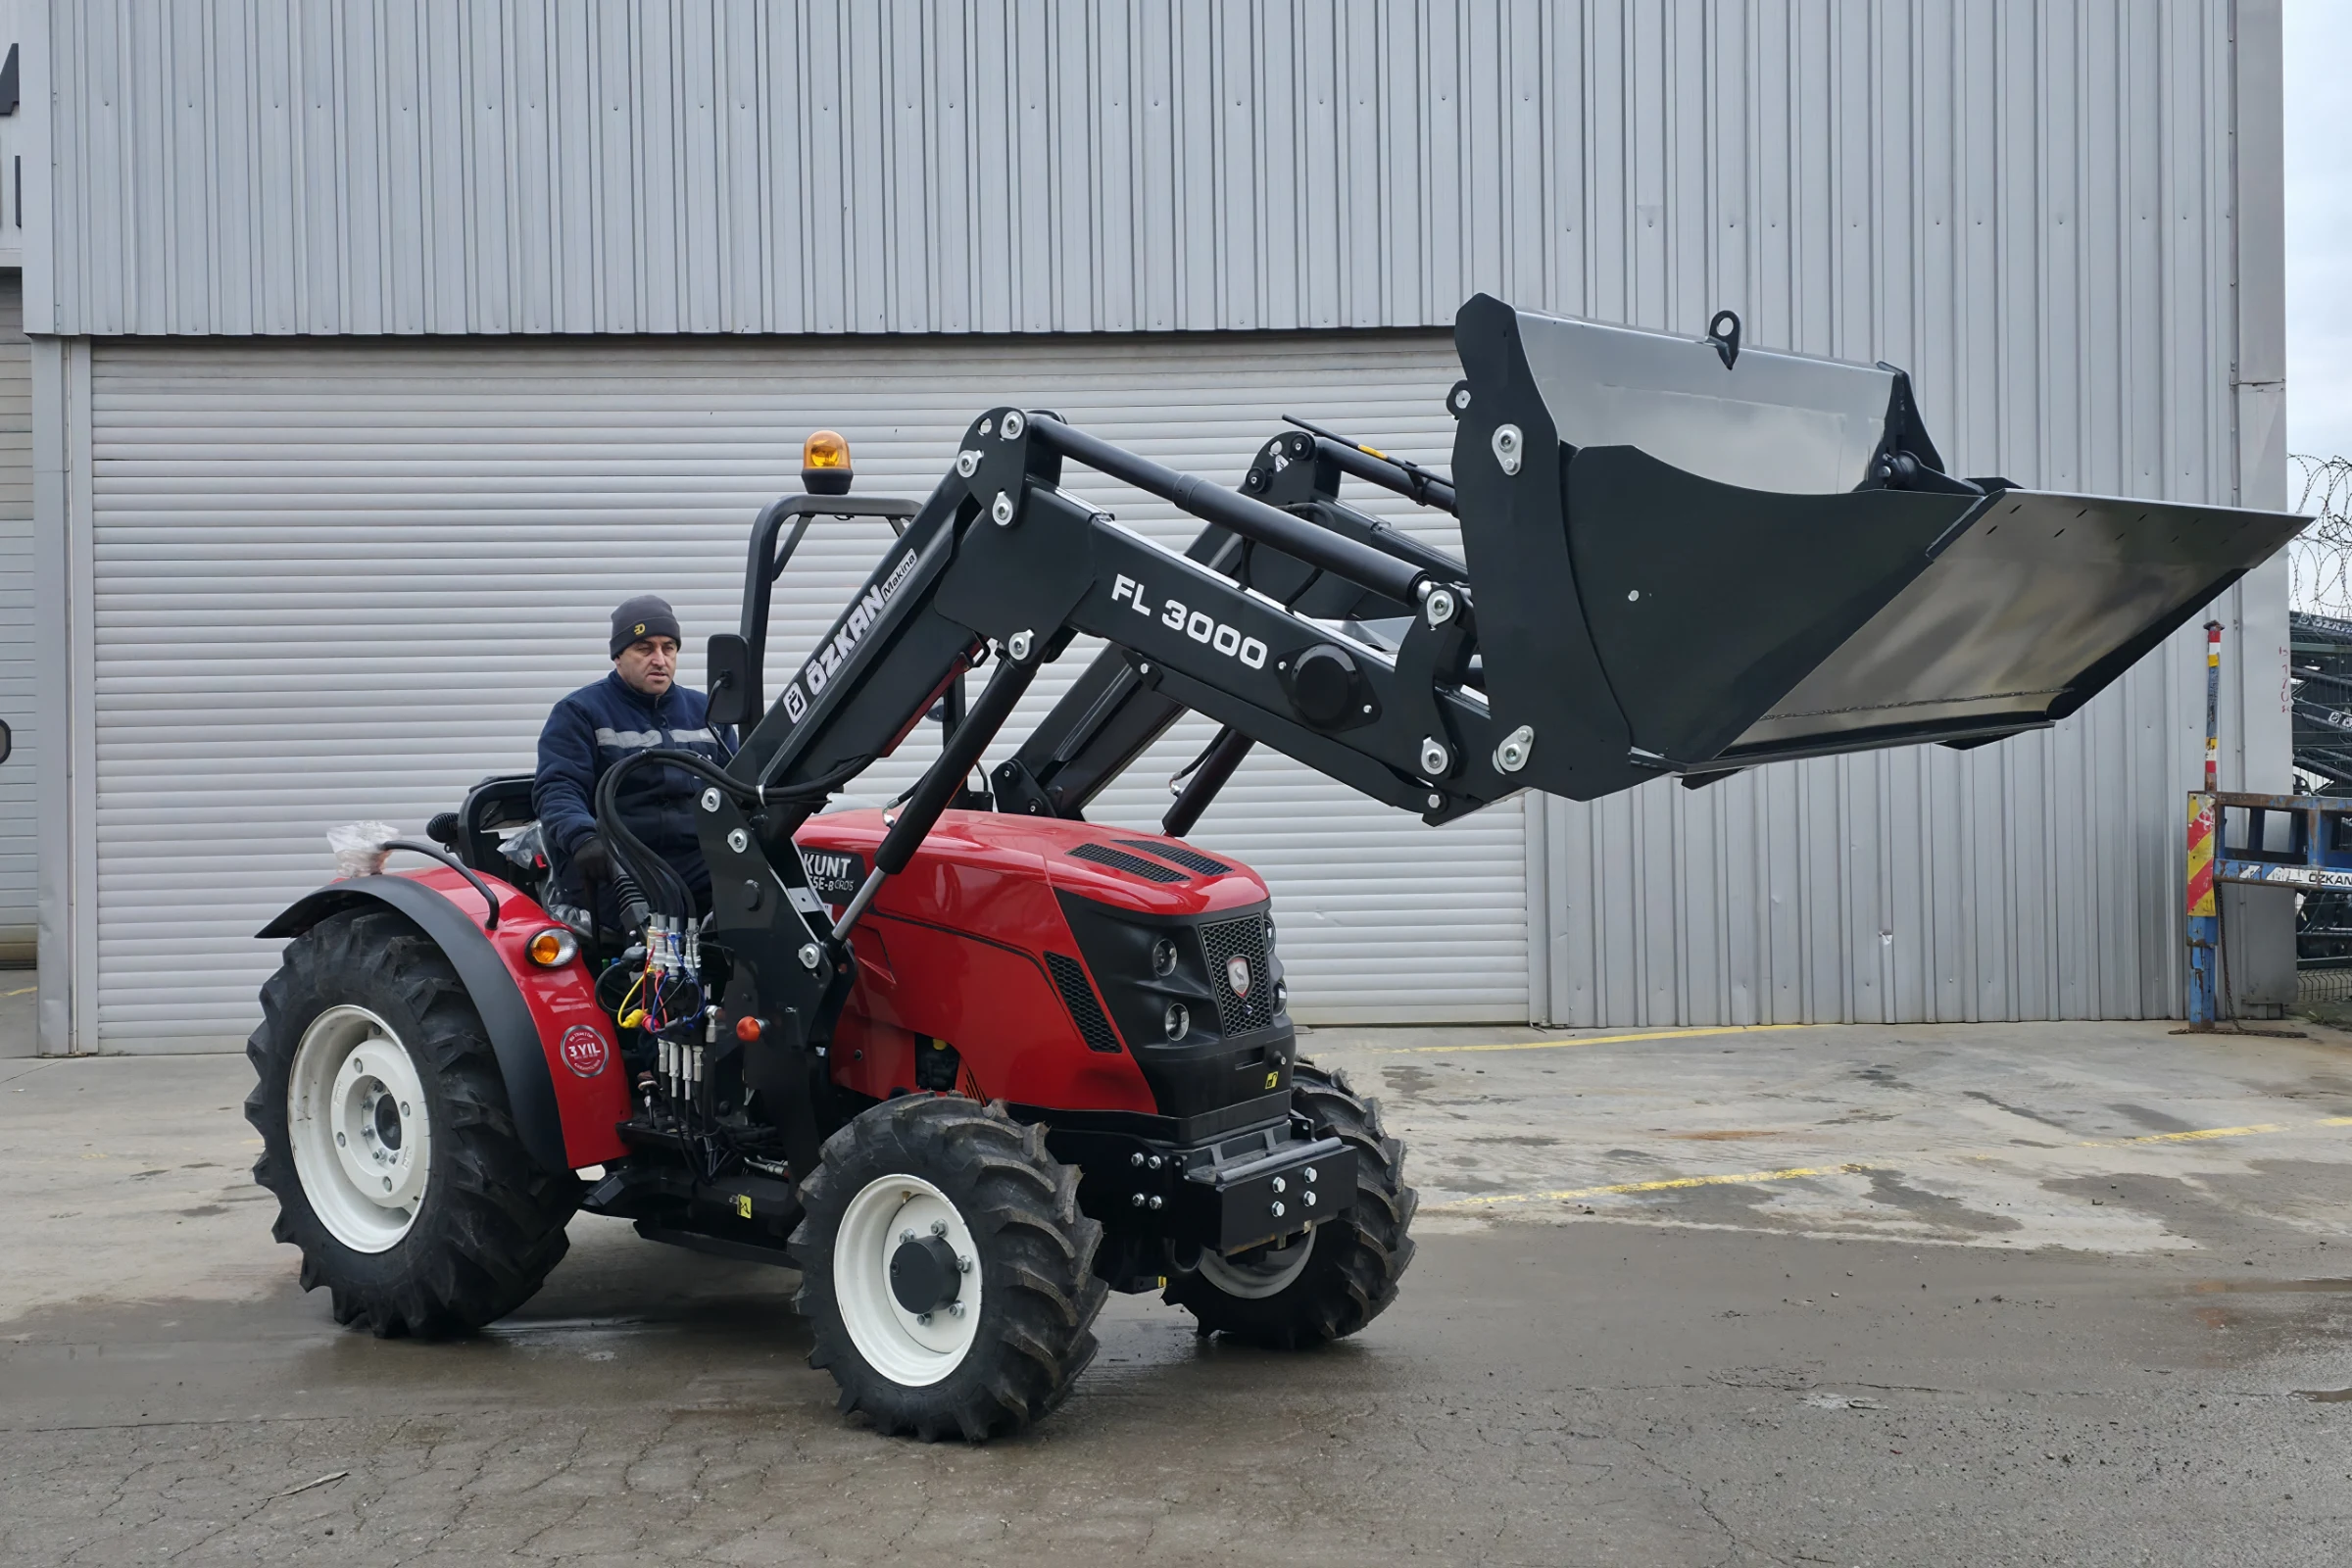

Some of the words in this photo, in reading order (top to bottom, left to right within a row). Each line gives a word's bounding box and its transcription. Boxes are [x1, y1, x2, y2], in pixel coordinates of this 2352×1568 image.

[805, 584, 887, 696] ÖZKAN
[882, 553, 917, 599] Makina
[1110, 573, 1152, 617] FL
[1161, 599, 1268, 670] 3000
[804, 853, 852, 879] KUNT
[808, 875, 834, 892] 5E-B
[568, 1045, 577, 1057] 3
[577, 1043, 601, 1055] YIL
